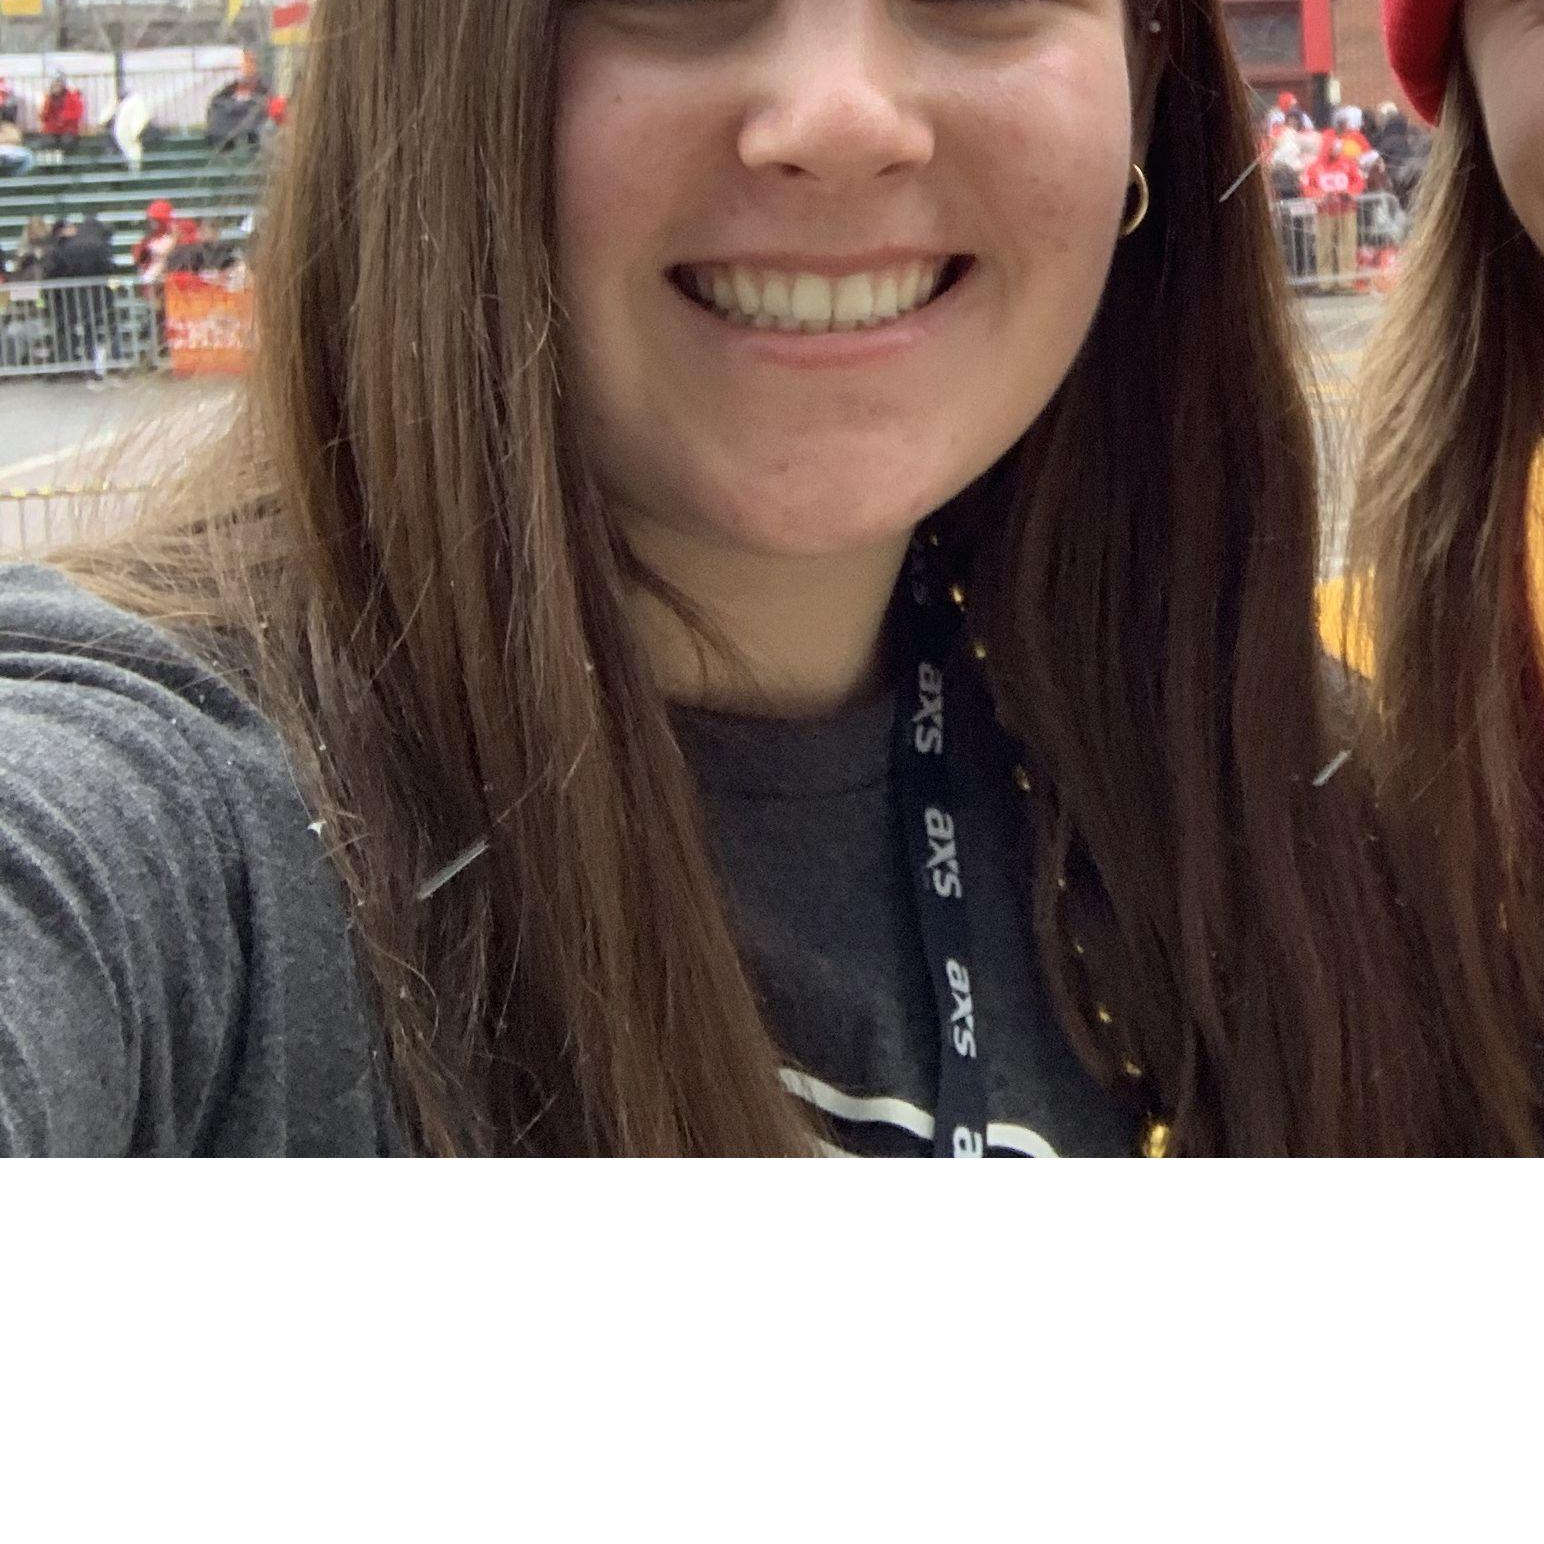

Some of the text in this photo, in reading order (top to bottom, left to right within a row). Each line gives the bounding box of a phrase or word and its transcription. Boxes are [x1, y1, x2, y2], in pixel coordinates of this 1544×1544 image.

[911, 661, 943, 755] axs
[924, 806, 963, 899] axs
[945, 957, 978, 1059] axs
